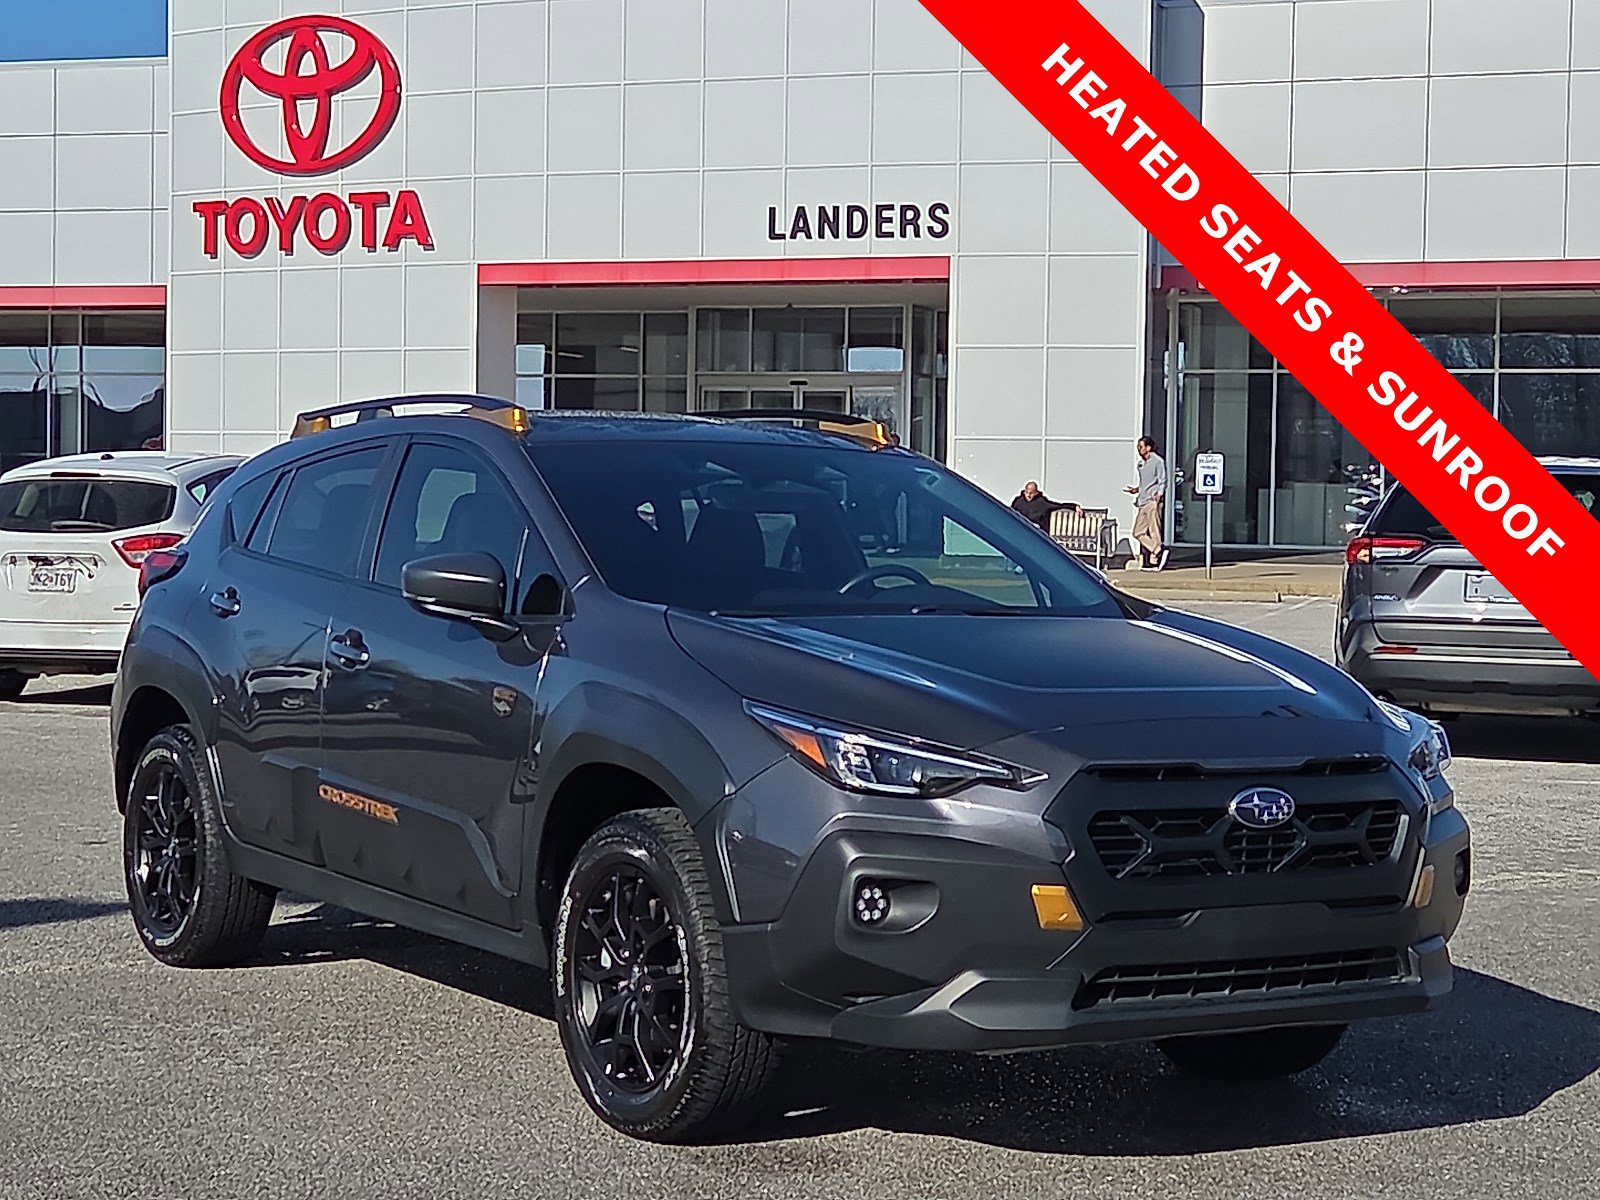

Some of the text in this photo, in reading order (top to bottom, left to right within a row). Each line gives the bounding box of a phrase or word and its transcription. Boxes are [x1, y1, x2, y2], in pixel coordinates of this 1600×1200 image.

[192, 189, 434, 258] TOYOTA
[768, 202, 950, 241] LANDERS
[318, 783, 399, 825] CROSSTREK
